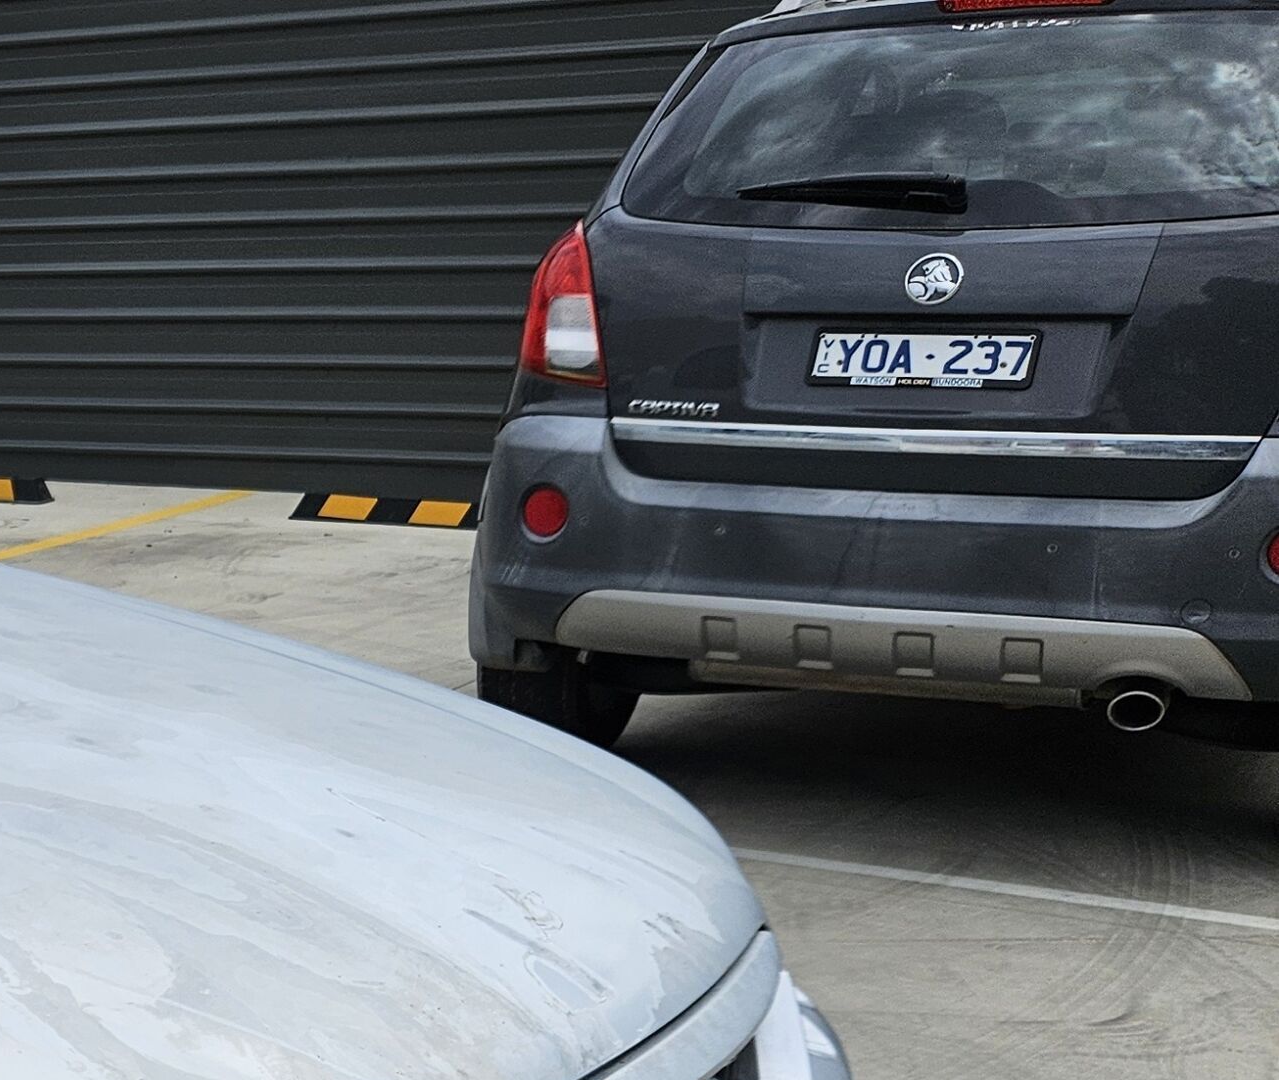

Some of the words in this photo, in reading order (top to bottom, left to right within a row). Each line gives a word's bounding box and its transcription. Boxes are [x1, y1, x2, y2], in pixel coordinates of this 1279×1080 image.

[840, 339, 912, 374] YOA
[942, 339, 1033, 376] 237
[897, 378, 930, 386] HOLDEN
